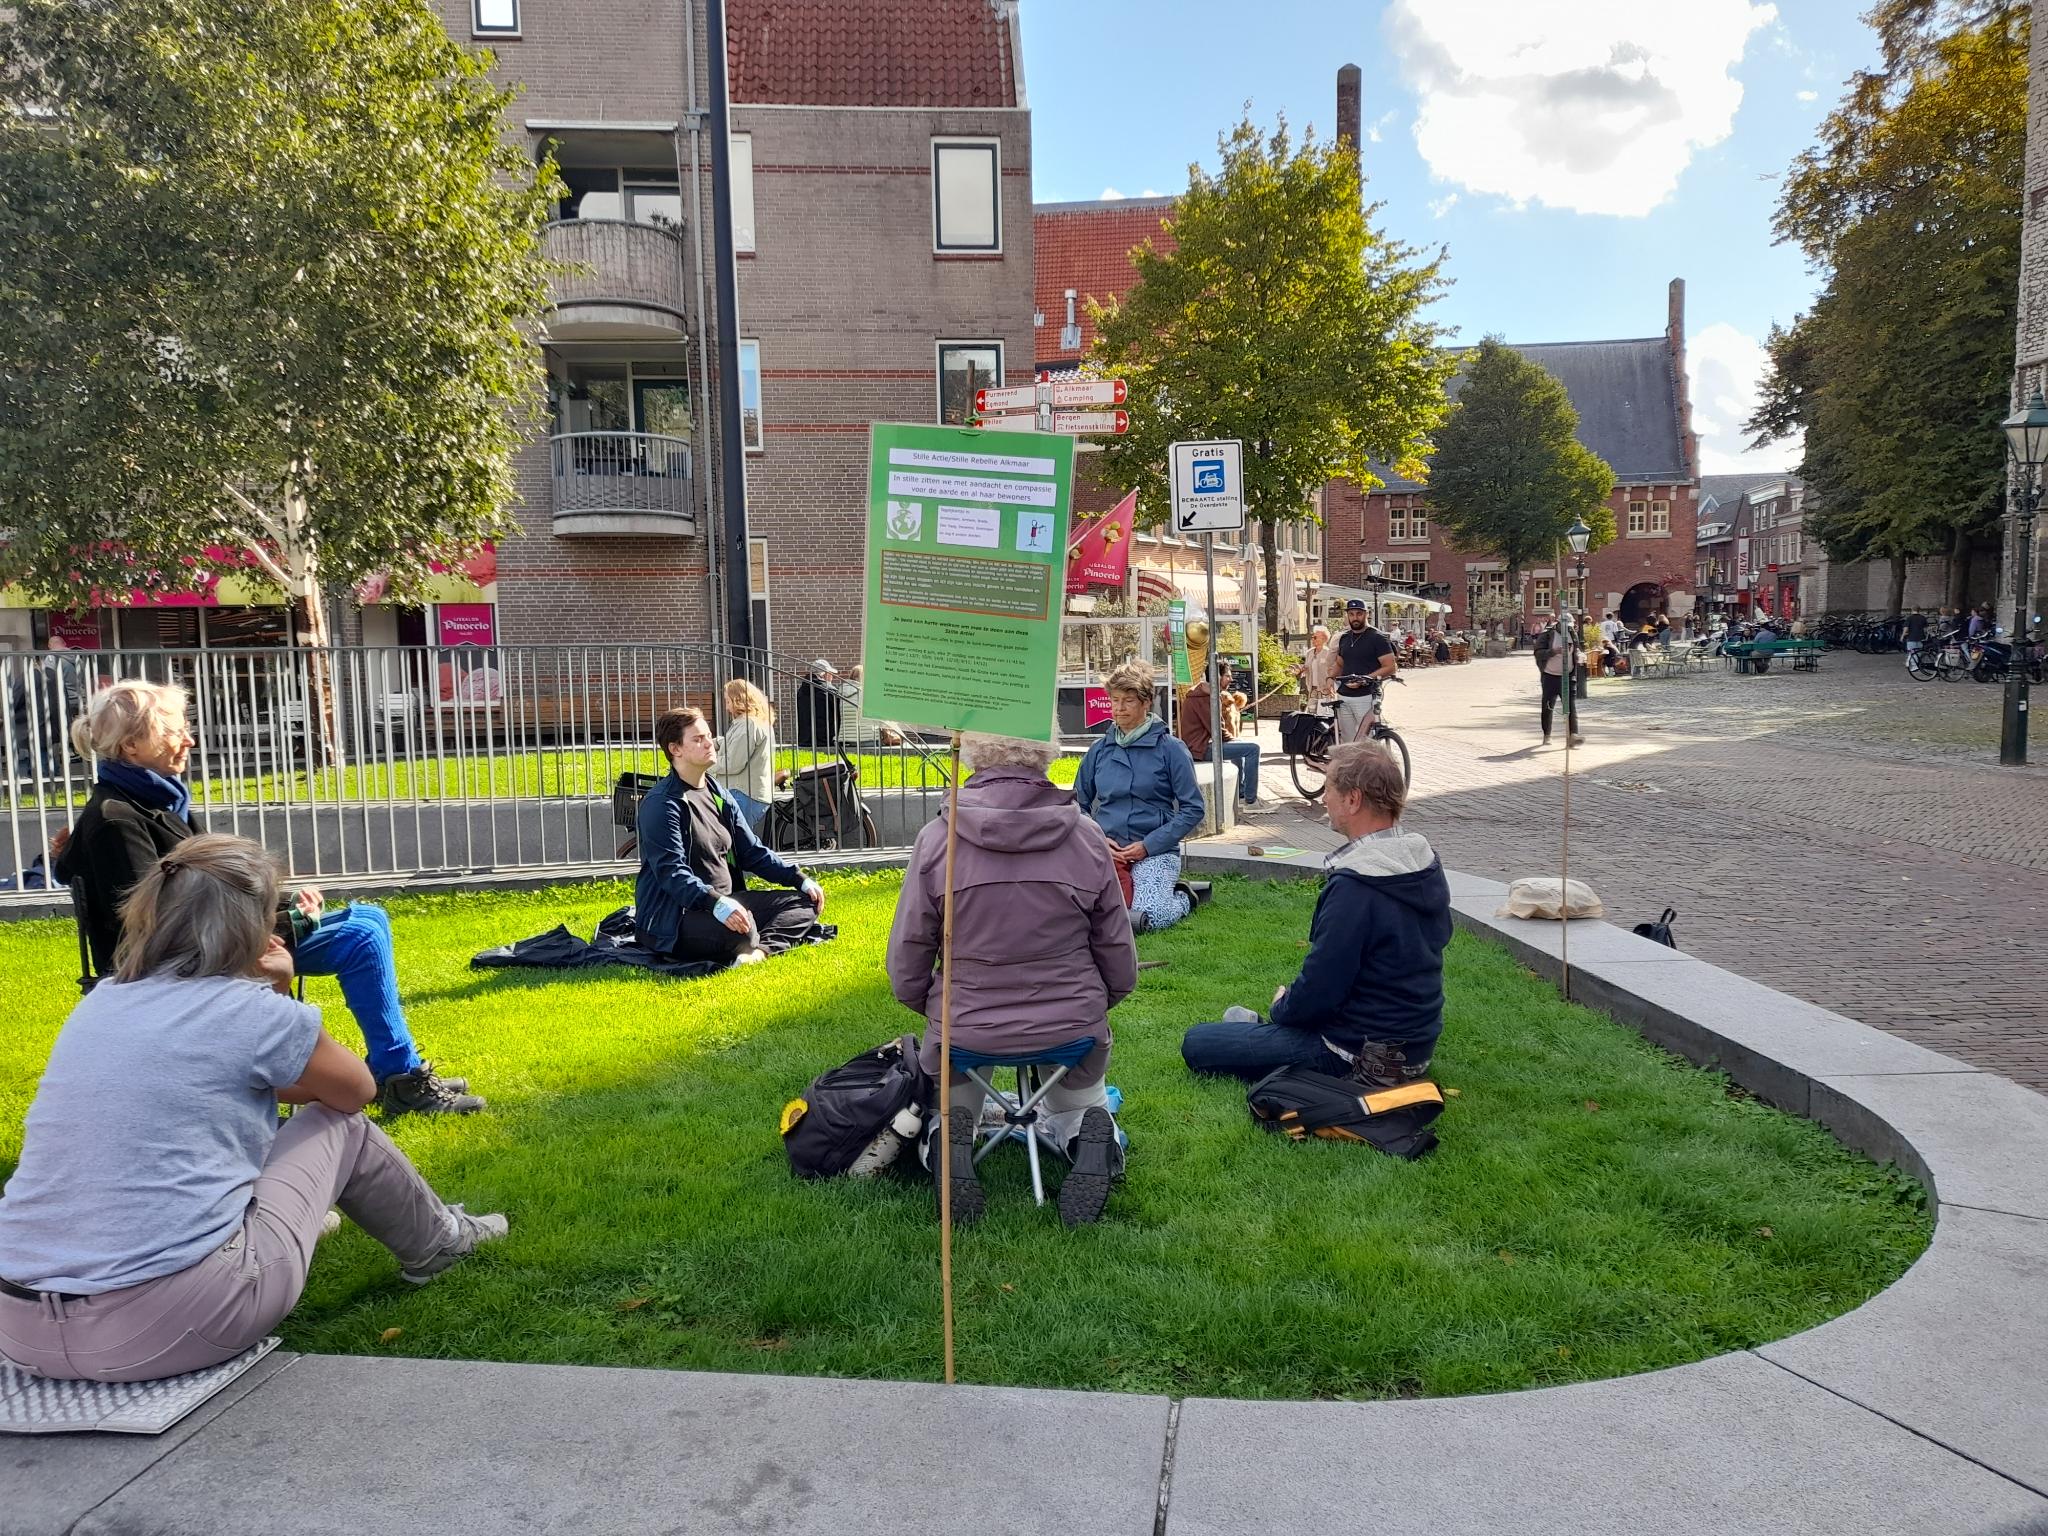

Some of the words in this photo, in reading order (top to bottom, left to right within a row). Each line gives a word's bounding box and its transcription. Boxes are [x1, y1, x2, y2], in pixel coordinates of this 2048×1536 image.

[986, 390, 1018, 398] Purmerend
[1192, 447, 1225, 458] Gratis
[913, 452, 930, 460] Stille
[931, 454, 969, 464] Actie/Stille
[970, 456, 998, 466] Rebellie
[1000, 458, 1030, 468] Alkmaar
[921, 477, 940, 485] zitten
[969, 480, 1001, 490] aandacht
[1014, 484, 1052, 494] compassie
[940, 488, 958, 496] aarde
[979, 490, 996, 499] haar
[997, 492, 1031, 501] bewoners
[1083, 567, 1120, 581] Pinoccio
[52, 625, 97, 636] Pinoccio
[442, 620, 490, 631] Pinoccio
[1088, 698, 1112, 709] Pino
